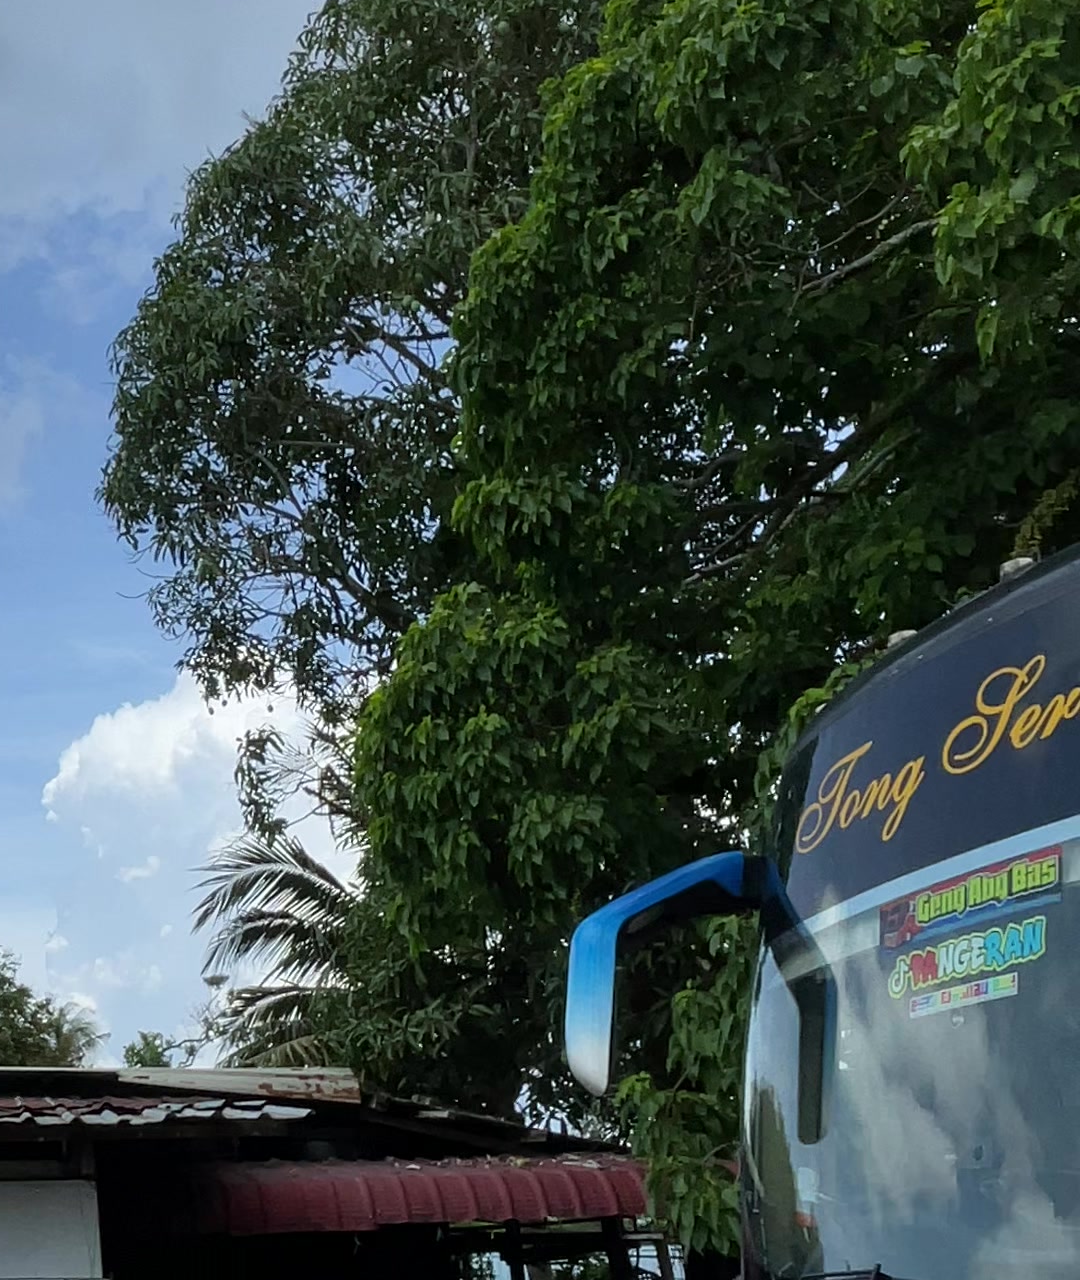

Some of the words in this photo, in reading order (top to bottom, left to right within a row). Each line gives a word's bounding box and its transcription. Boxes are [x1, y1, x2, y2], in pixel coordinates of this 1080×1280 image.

[796, 741, 926, 853] Tong
[916, 890, 967, 924] Geng
[1010, 856, 1058, 895] Bas
[909, 918, 1043, 988] PANGERAN
